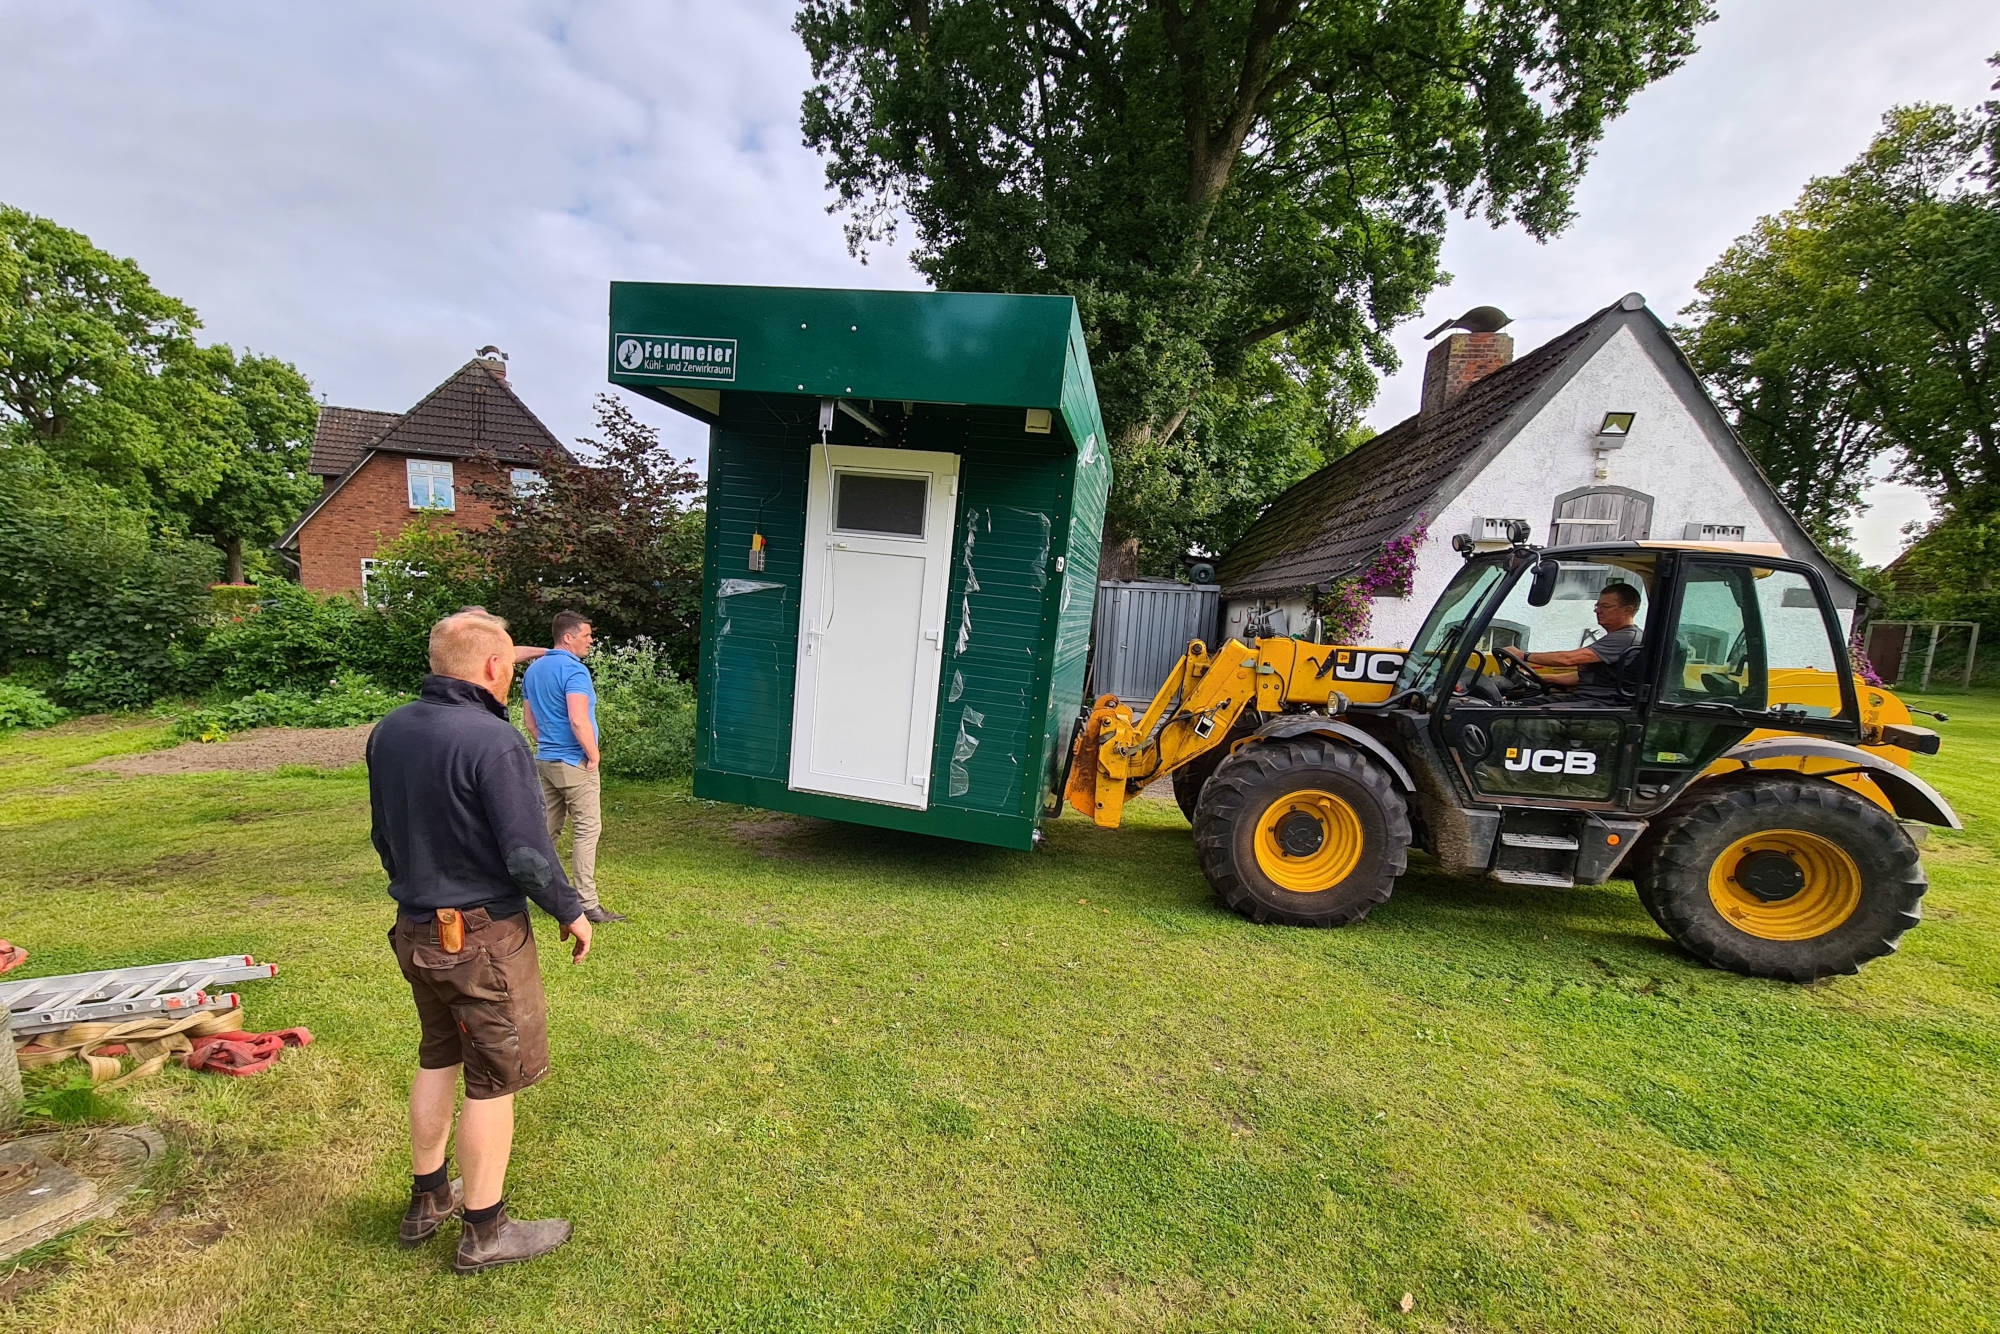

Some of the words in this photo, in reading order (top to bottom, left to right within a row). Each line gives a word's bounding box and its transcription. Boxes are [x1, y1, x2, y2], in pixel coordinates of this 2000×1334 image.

[644, 341, 733, 363] Feldmeier
[644, 360, 664, 370] Kühl-
[666, 361, 681, 372] und
[683, 361, 732, 375] Zerwirkraum
[1504, 748, 1597, 775] JCB
